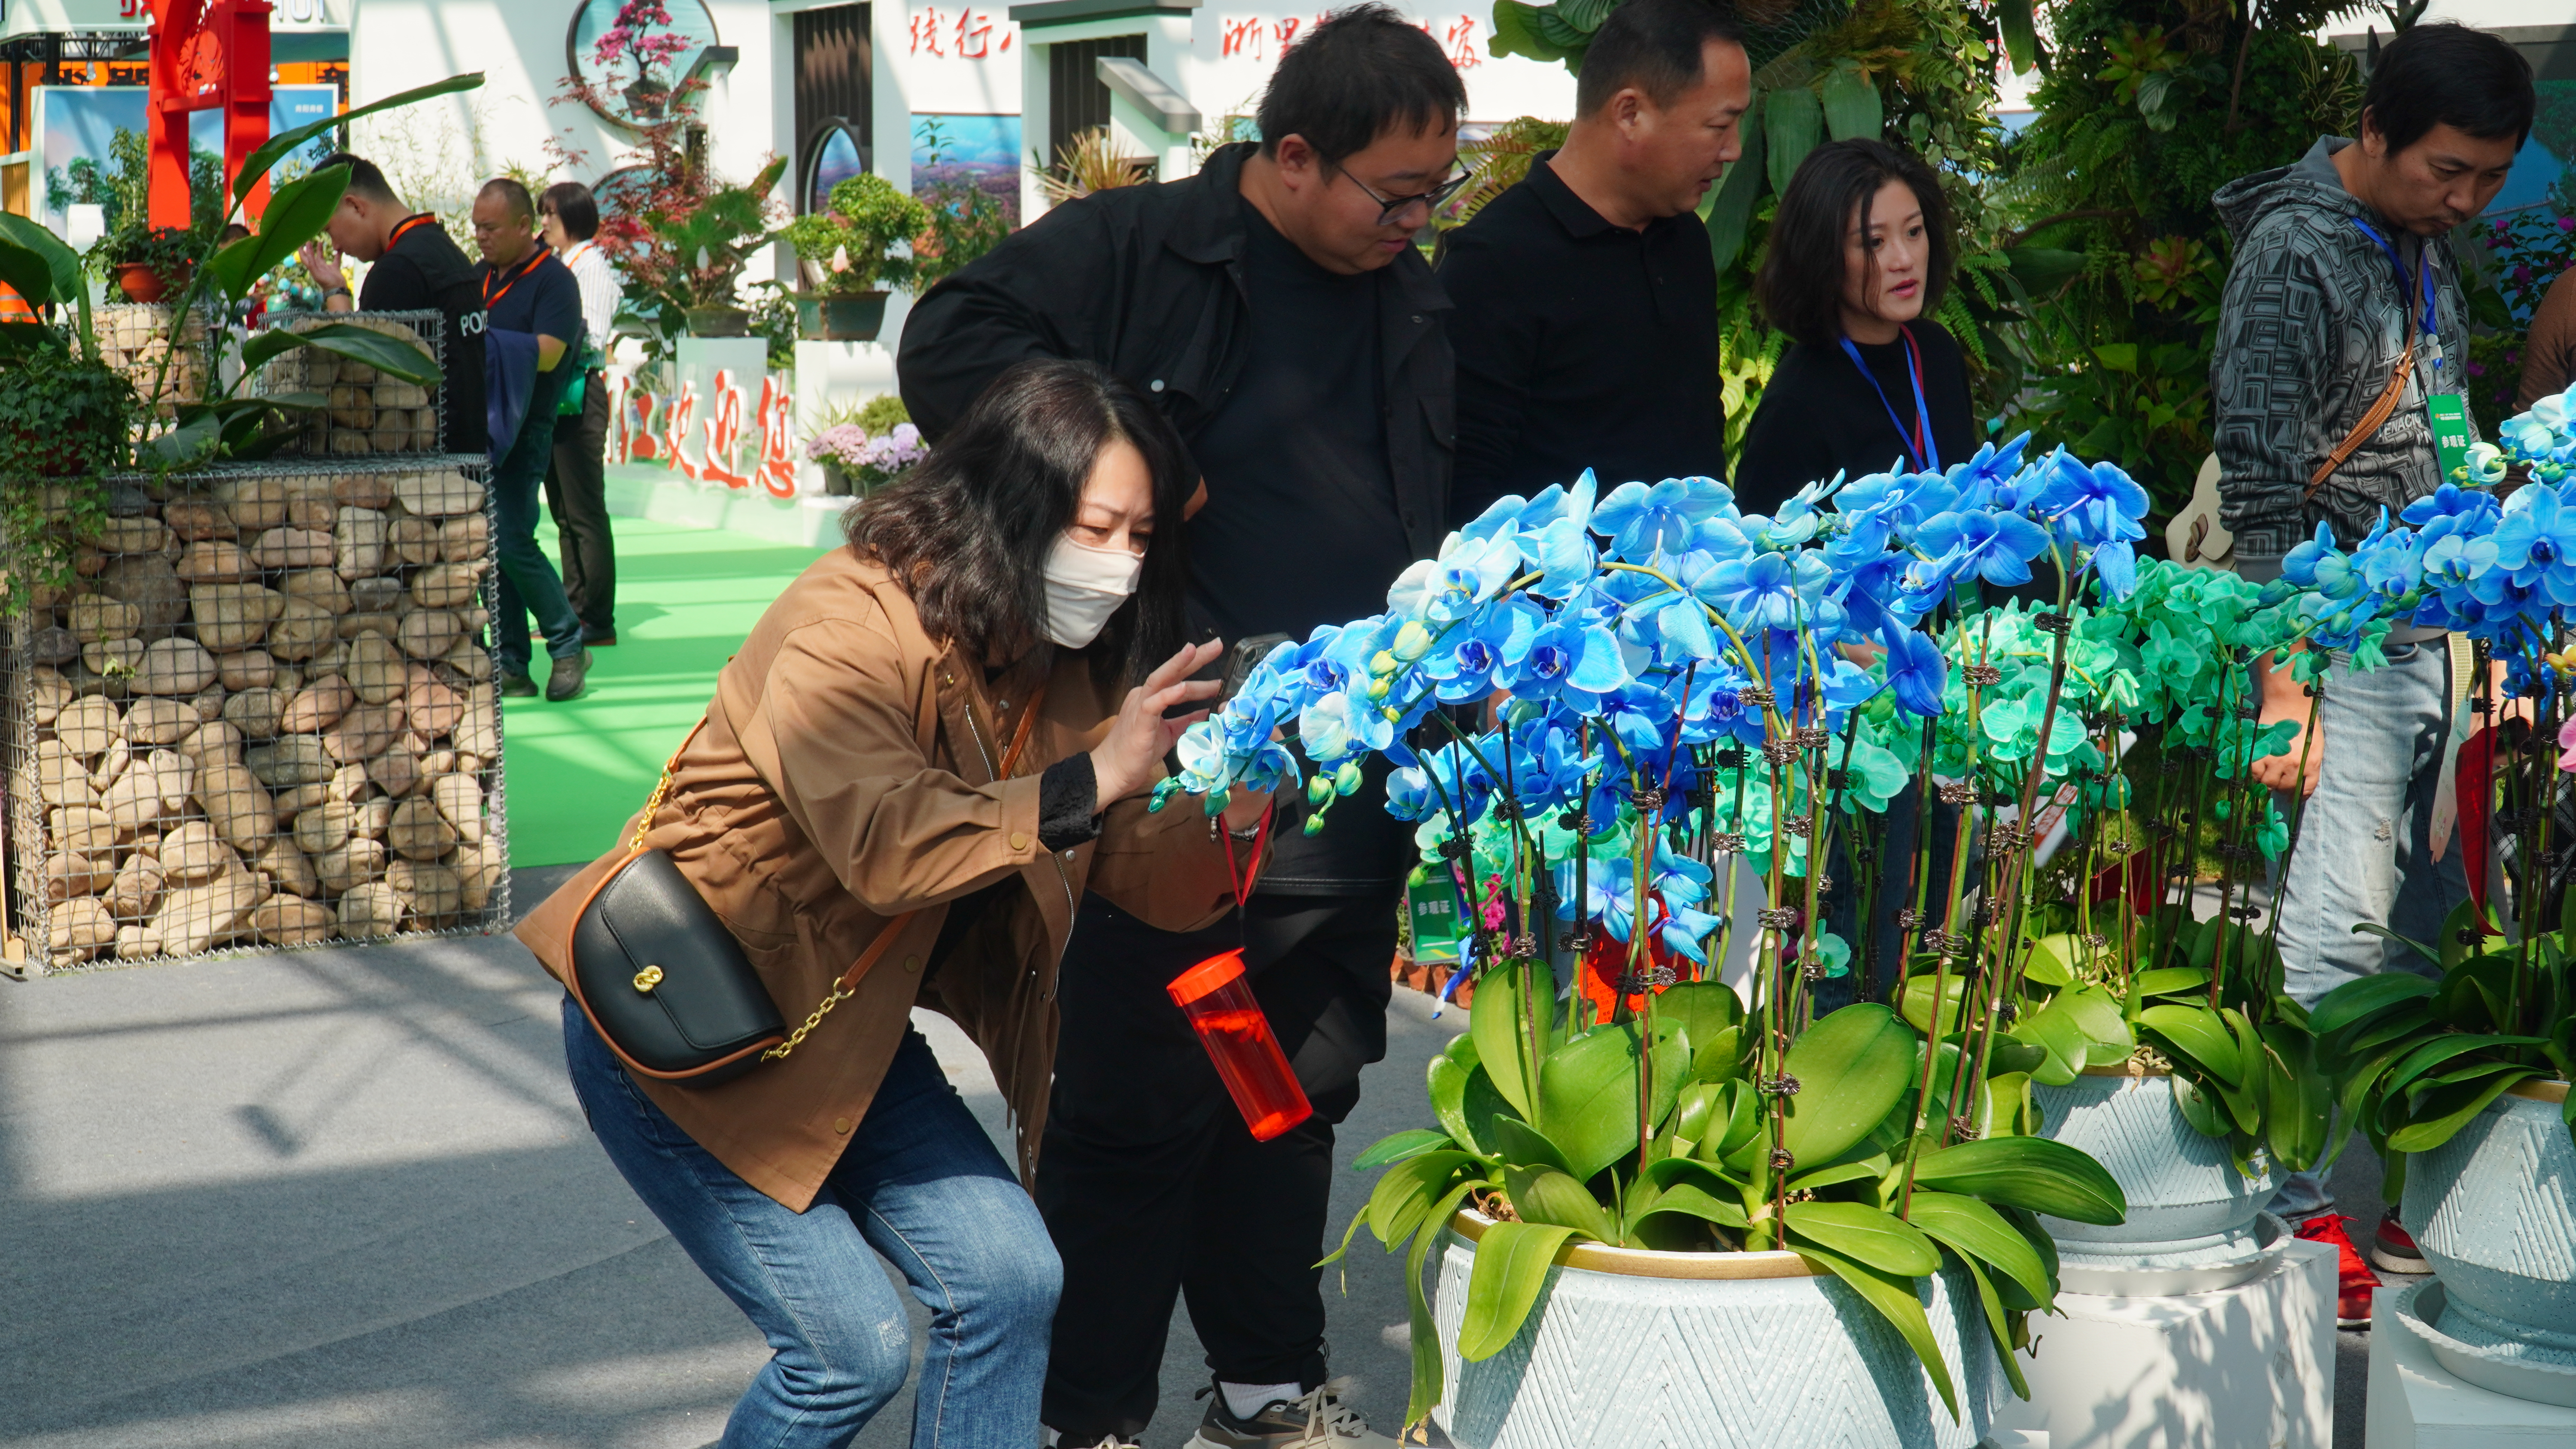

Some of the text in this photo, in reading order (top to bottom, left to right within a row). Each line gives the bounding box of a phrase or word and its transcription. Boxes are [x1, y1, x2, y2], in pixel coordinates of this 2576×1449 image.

[2442, 435, 2466, 449] 参观证
[1417, 900, 1452, 916] 参观证
